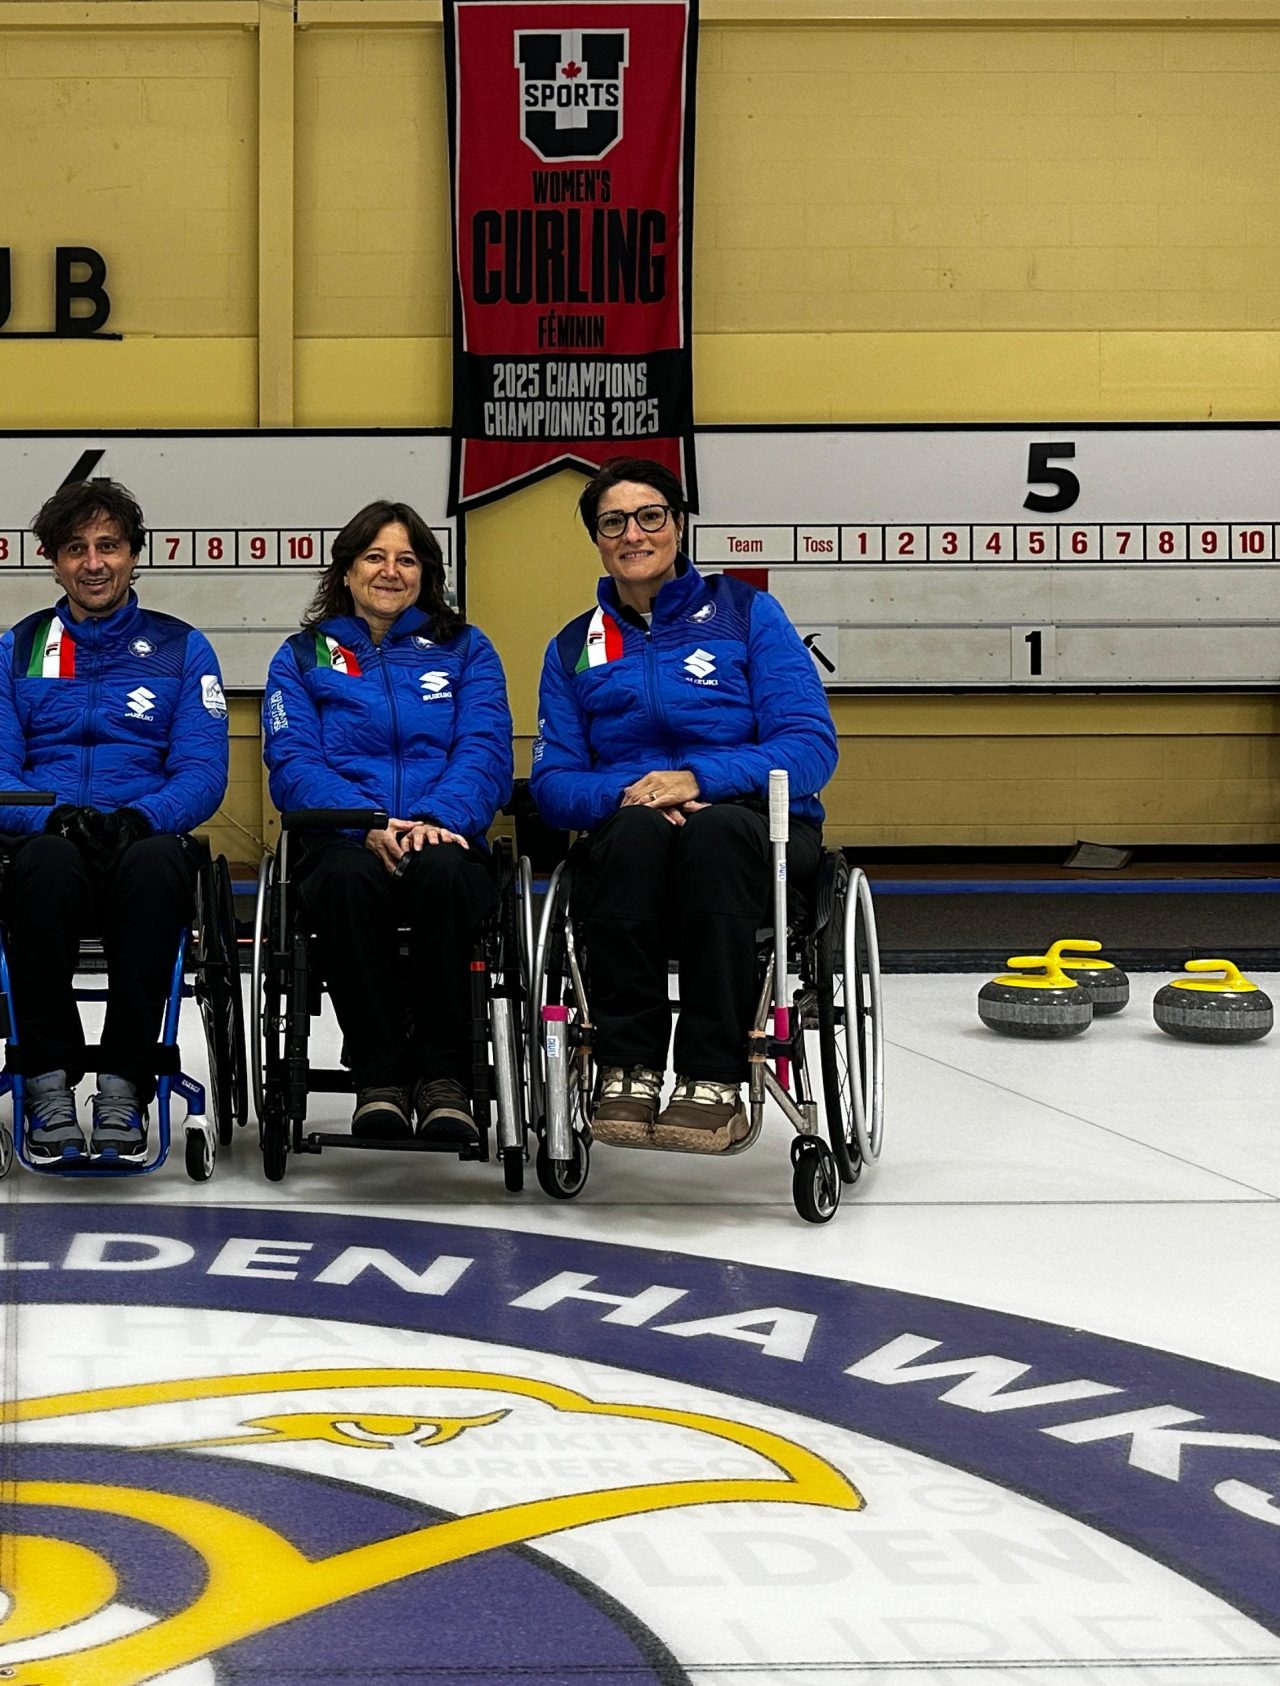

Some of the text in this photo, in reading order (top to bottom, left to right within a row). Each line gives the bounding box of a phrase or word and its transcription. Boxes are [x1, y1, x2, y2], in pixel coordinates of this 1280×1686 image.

[524, 83, 619, 107] SPORTS
[532, 168, 612, 204] WOMEN'S
[472, 208, 667, 305] CURLING
[537, 309, 605, 349] FÉMININ
[493, 362, 648, 398] 2025 CHAMPIONS
[483, 398, 660, 436] CHAMPIONNES 2025
[1023, 443, 1080, 513] 5
[165, 538, 181, 560] 7
[207, 537, 223, 560] 8
[250, 537, 267, 559] 9
[287, 537, 314, 559] 10
[727, 530, 1265, 555] Team Toss 1 2 3 4 5 6 7 8 9 10
[1024, 631, 1042, 676] 1
[422, 692, 453, 701] SUZUKI
[685, 677, 718, 686] ZUKI
